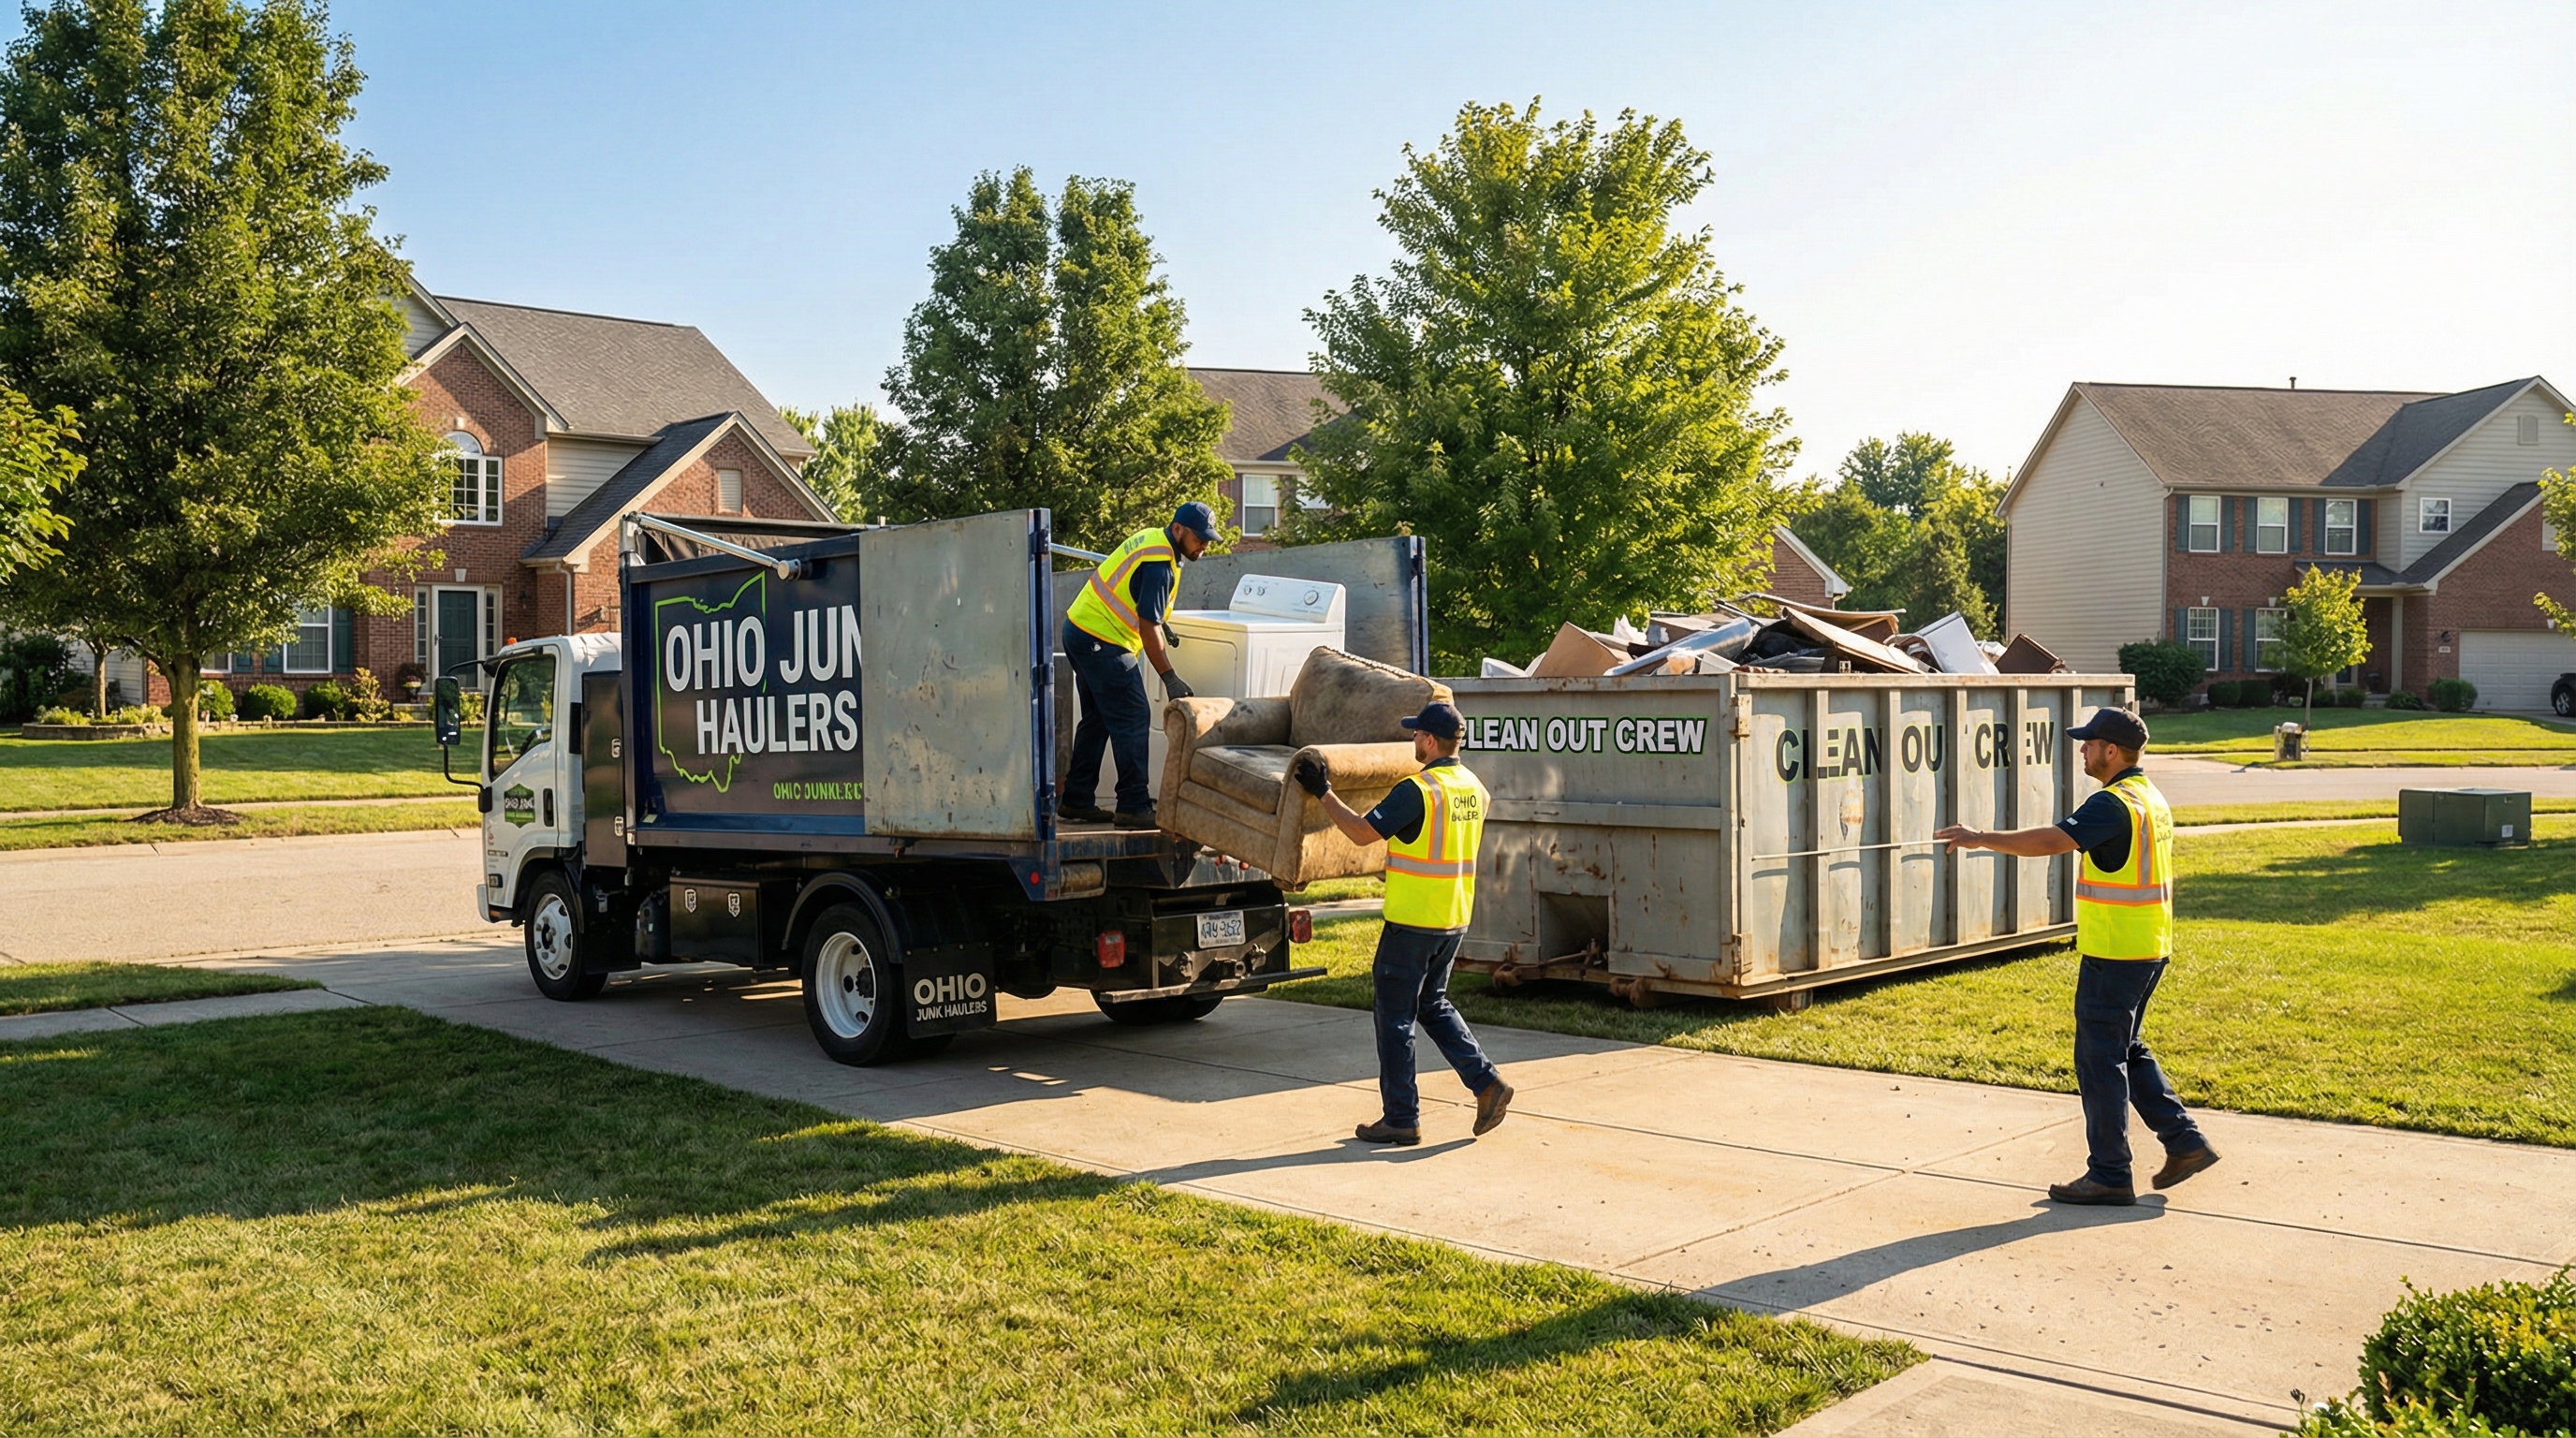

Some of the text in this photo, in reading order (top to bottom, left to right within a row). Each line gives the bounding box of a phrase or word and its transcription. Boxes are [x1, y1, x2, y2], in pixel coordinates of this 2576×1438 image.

[666, 604, 862, 693] OHIO JUN
[695, 689, 858, 756] HAULERS
[1460, 717, 1705, 754] LEAN OUT CREW
[1901, 725, 1968, 773] OU
[914, 972, 987, 1005] OHIO
[915, 1005, 944, 1021] JUNK
